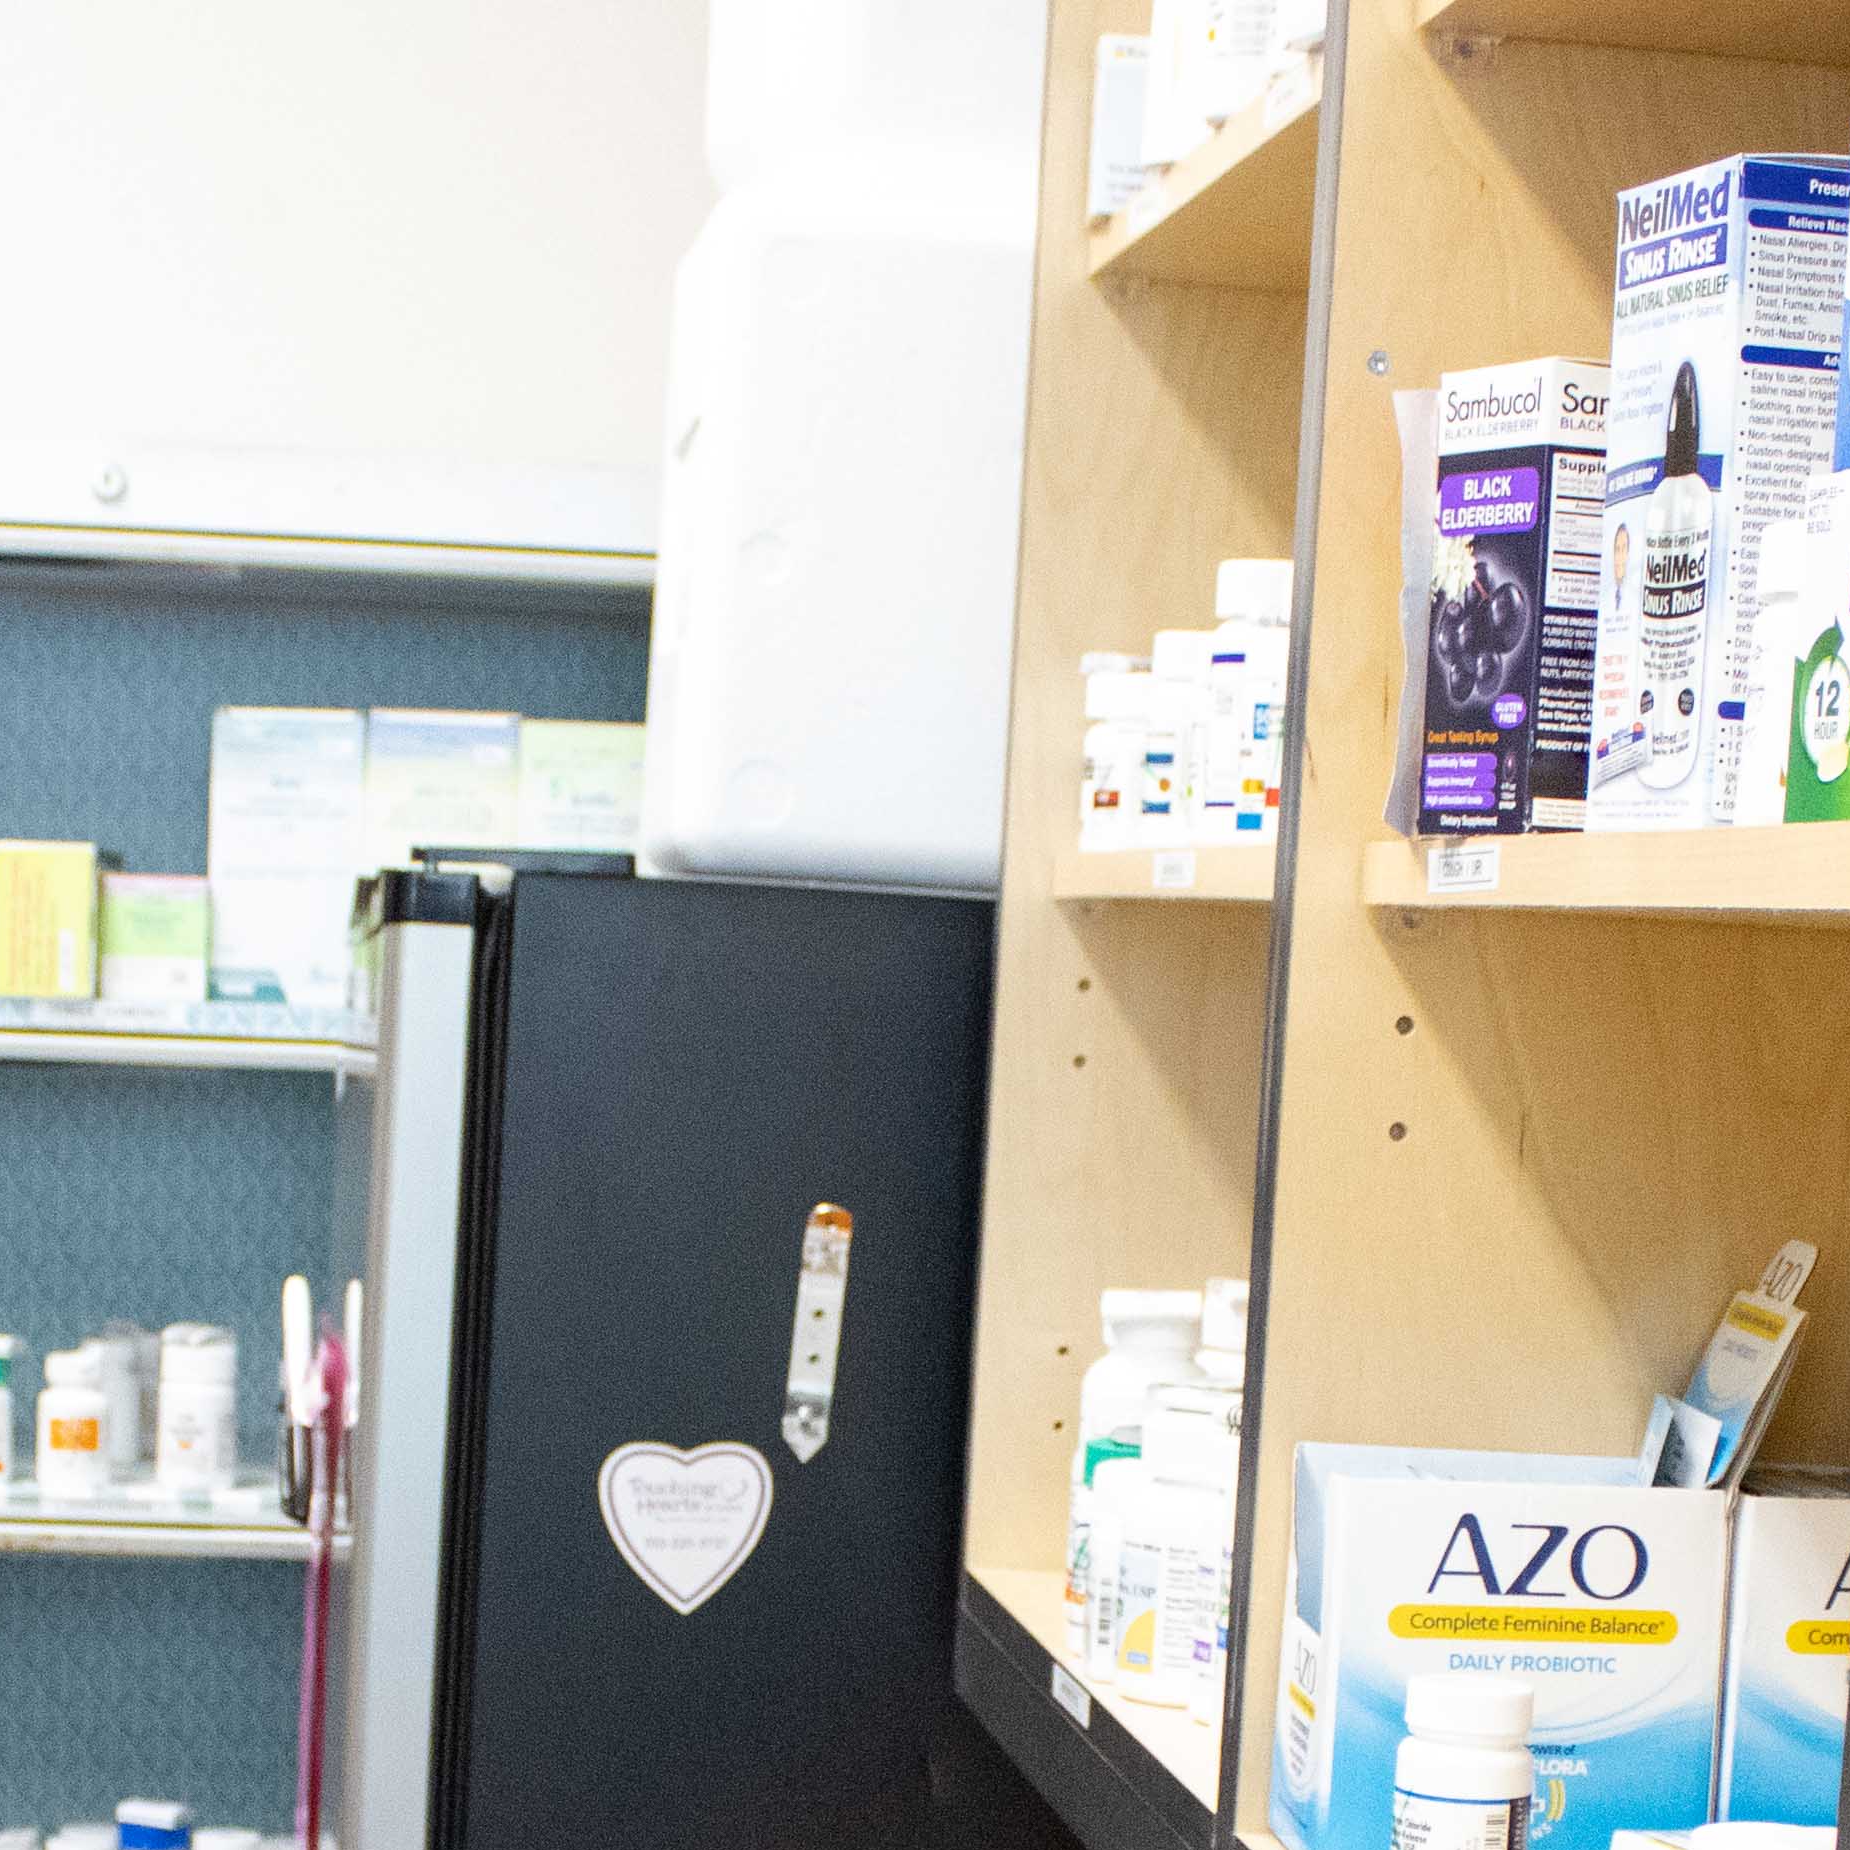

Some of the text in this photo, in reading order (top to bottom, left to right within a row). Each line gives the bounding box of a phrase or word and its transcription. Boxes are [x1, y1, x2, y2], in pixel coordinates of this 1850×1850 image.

[1621, 171, 1732, 246] NeilMed
[1624, 228, 1718, 284] SINUS RINSE
[1787, 253, 1828, 268] Pressure
[1758, 265, 1785, 280] Nasal
[1785, 268, 1836, 285] Symptoms
[1757, 282, 1784, 296] Nasal
[1754, 326, 1804, 343] Post-Nasal
[1807, 330, 1828, 346] Drip
[1751, 370, 1773, 386] Easy
[1445, 375, 1543, 424] Sambucol
[1748, 430, 1812, 446] Non-sedating
[1462, 474, 1513, 502] BLACK
[1440, 501, 1535, 530] ELDERBERRY
[1815, 679, 1841, 718] 12
[1426, 1512, 1649, 1602] AZO
[1409, 1612, 1661, 1637] Complete Feminine Balance
[1449, 1652, 1618, 1675] DAILY PROBIOTIC
